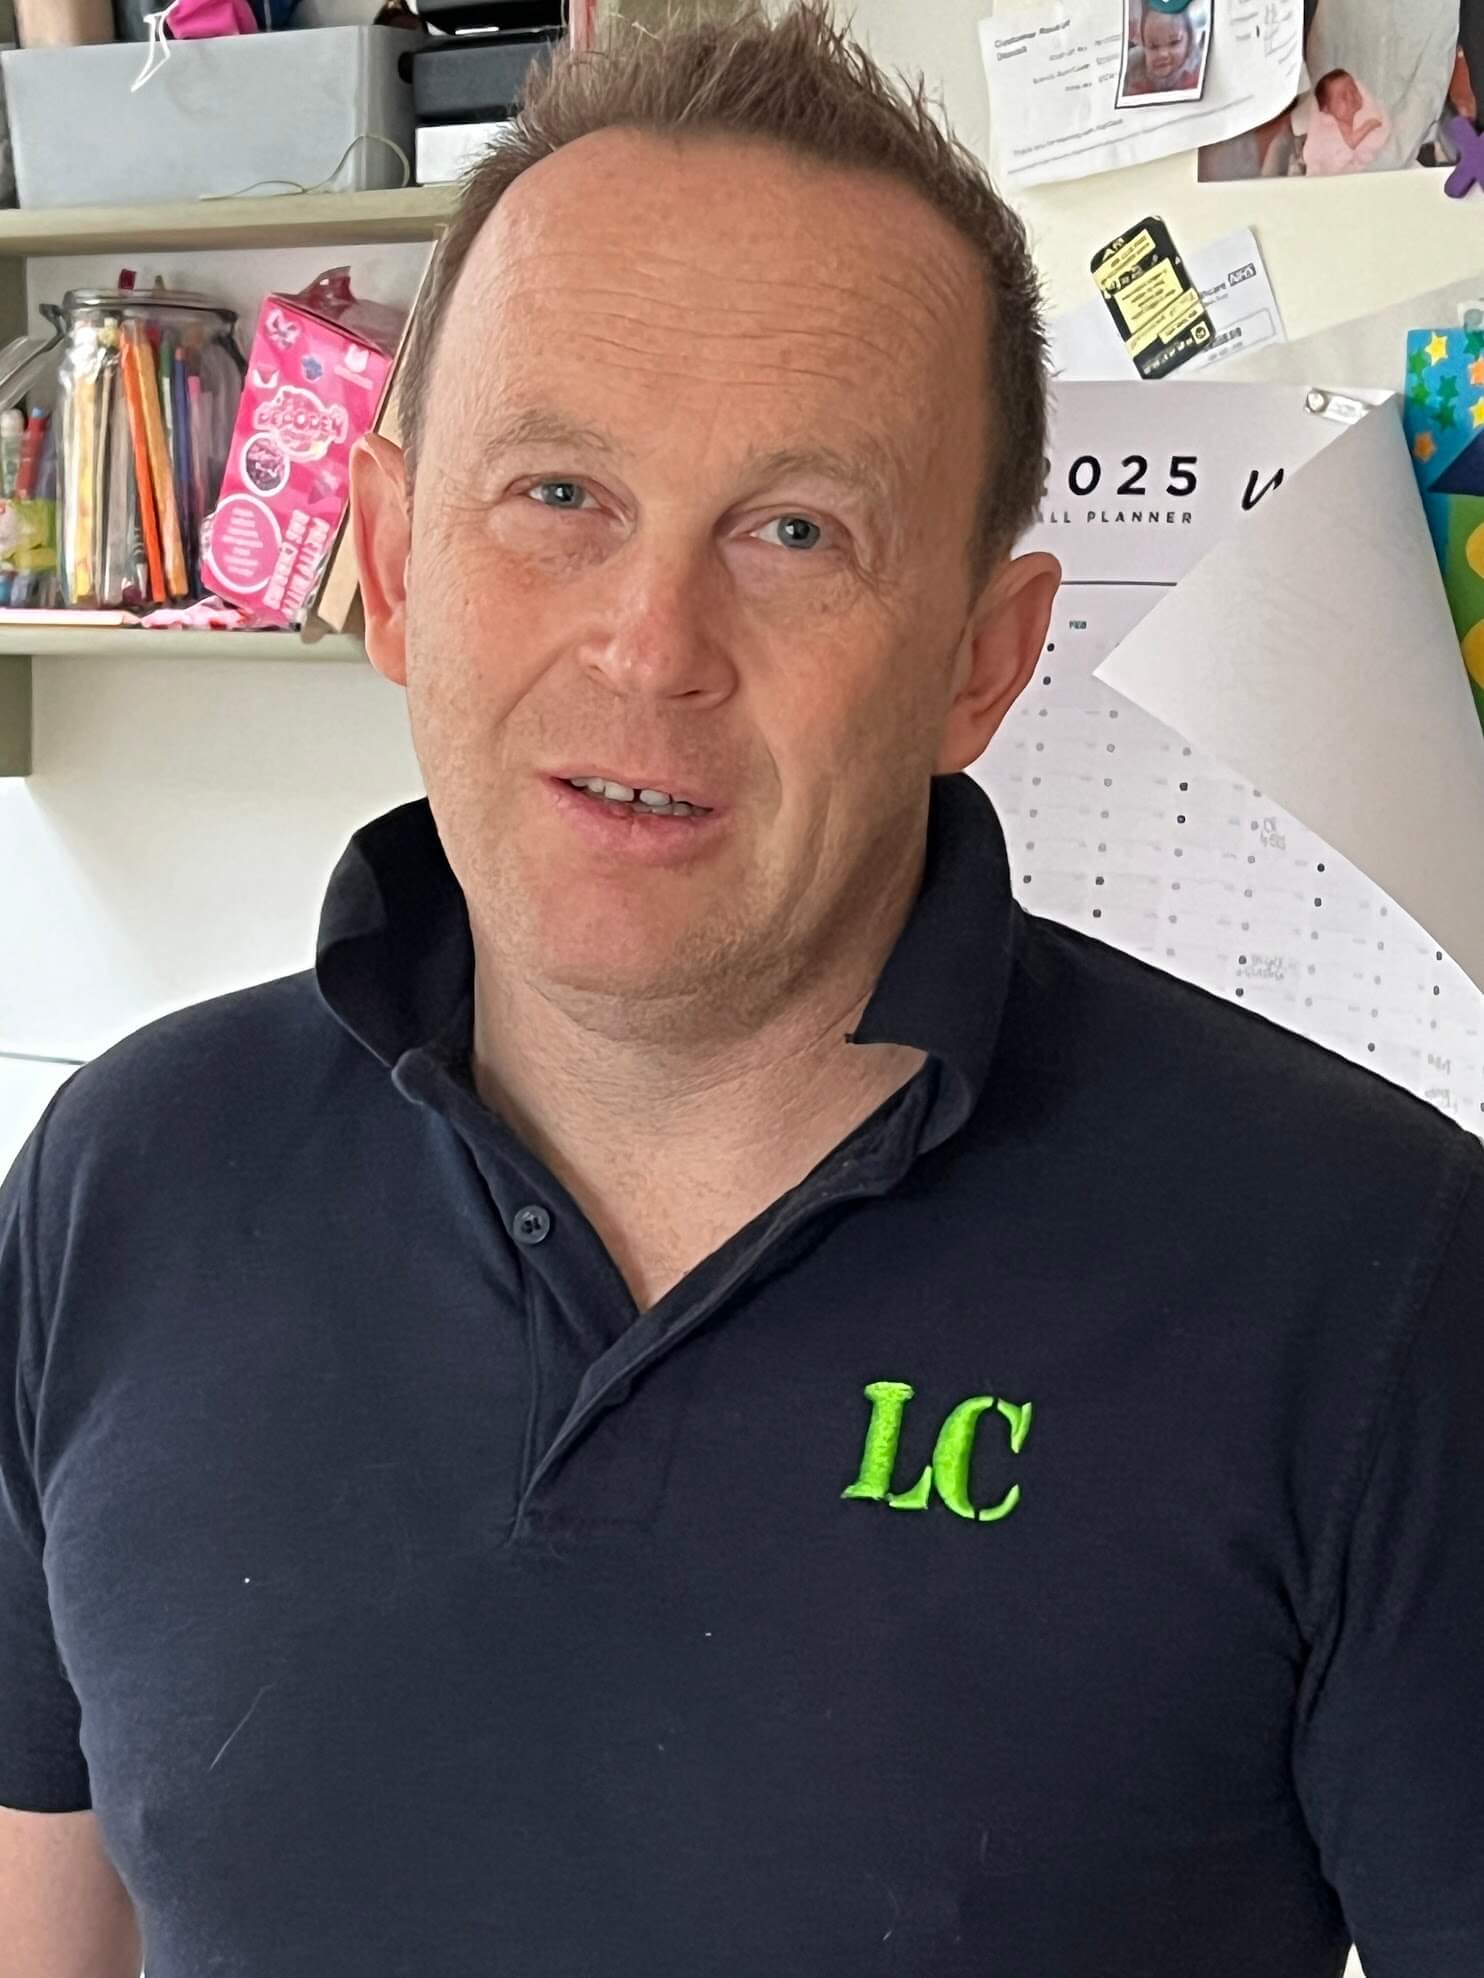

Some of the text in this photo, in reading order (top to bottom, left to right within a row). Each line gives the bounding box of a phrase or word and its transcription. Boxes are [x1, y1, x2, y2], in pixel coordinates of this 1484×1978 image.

[1044, 454, 1198, 497] 025
[1087, 510, 1192, 525] PLANNER
[840, 1381, 1032, 1522] LC
